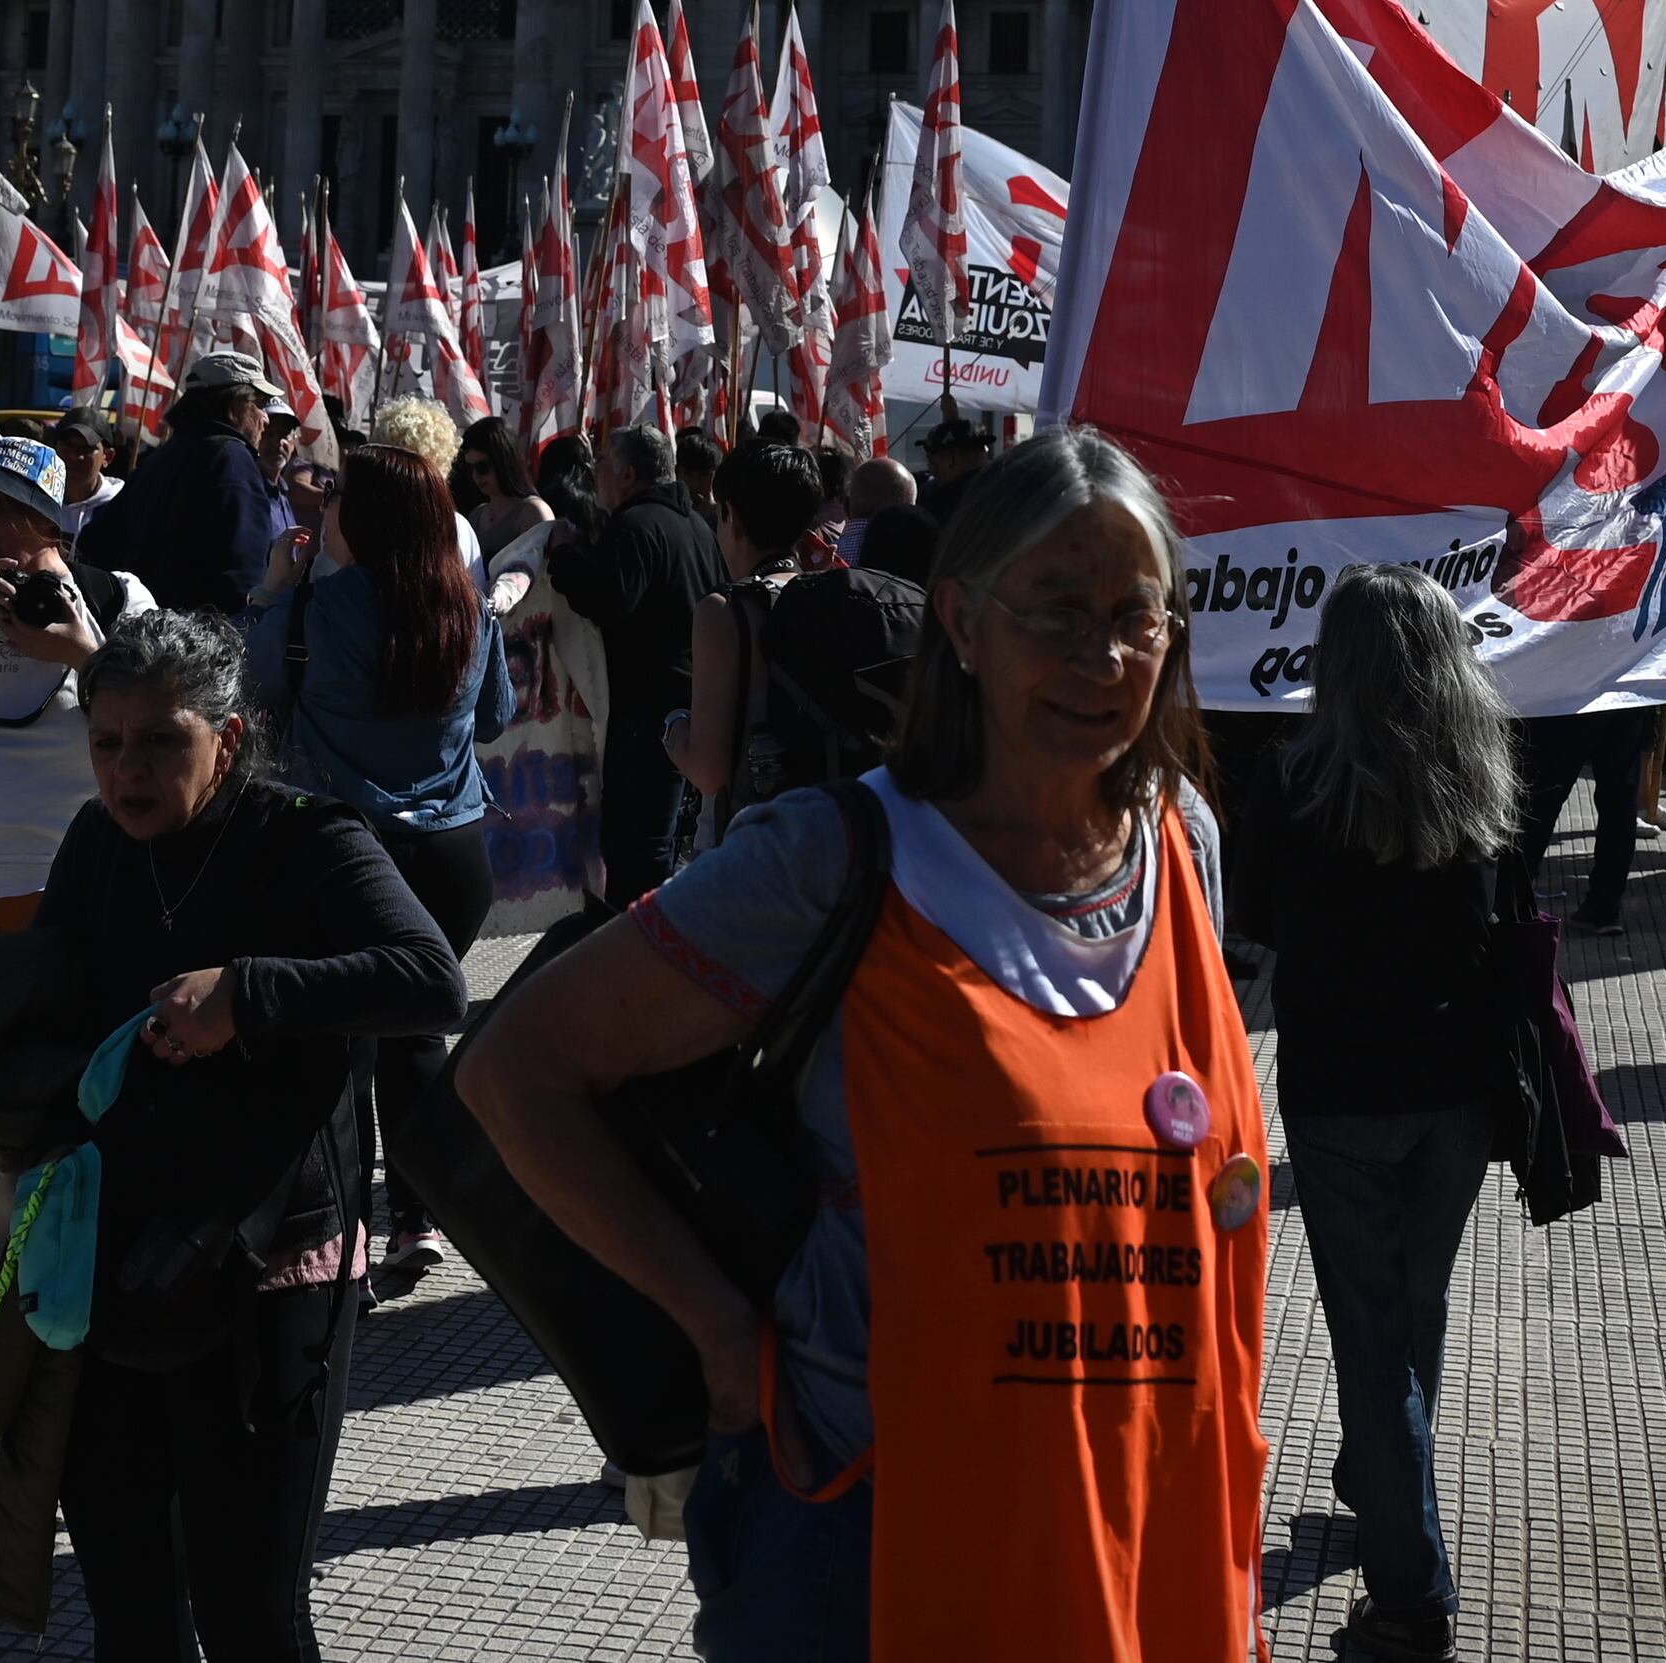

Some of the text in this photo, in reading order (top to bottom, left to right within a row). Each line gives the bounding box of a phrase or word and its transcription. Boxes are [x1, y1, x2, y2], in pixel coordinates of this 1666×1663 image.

[1185, 548, 1326, 630] abajo
[998, 1168, 1192, 1211] PLENARIO DE
[984, 1241, 1202, 1288] TRABAJADORES
[1007, 1319, 1185, 1362] JUBILADOS
